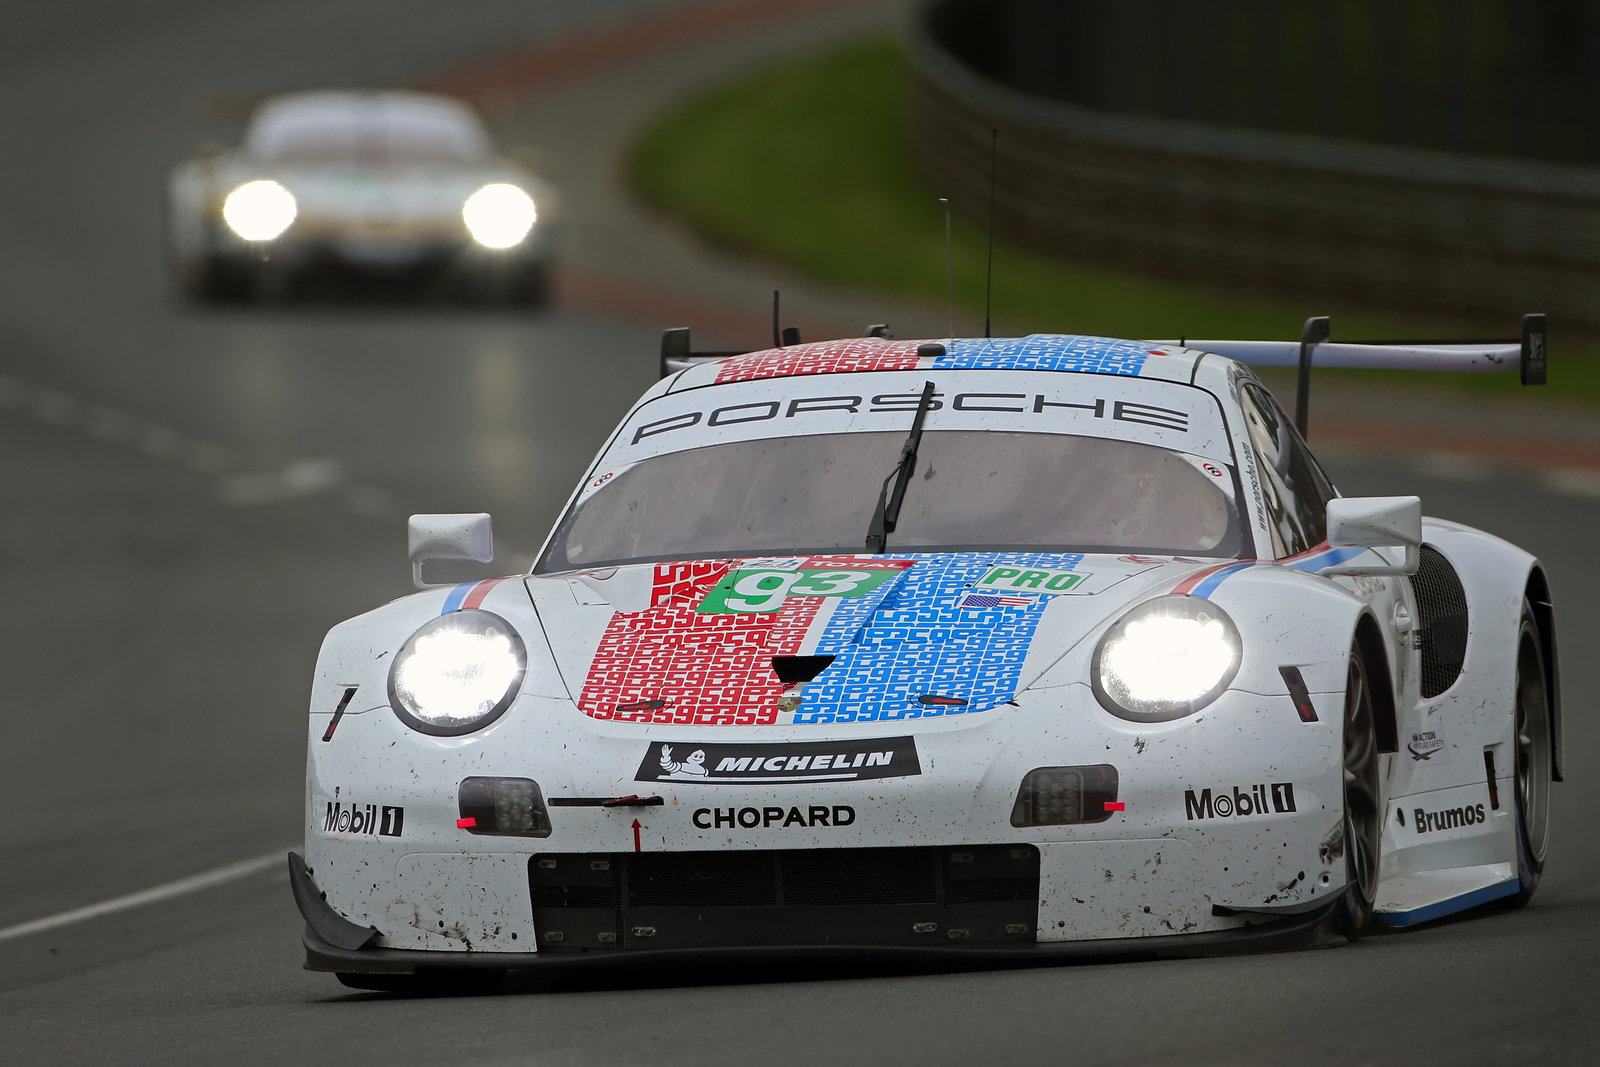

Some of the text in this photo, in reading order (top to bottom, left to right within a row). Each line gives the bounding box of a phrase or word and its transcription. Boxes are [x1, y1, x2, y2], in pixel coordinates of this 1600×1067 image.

[631, 393, 1189, 446] PORSCHE
[810, 560, 905, 569] TOTAL
[981, 567, 1083, 591] PRO
[724, 571, 872, 613] 93
[714, 751, 895, 773] MICHELIN
[692, 805, 856, 829] CHOPARD
[1184, 783, 1270, 821] Mobil
[324, 801, 377, 835] Mobil
[1413, 803, 1486, 834] Brumos
